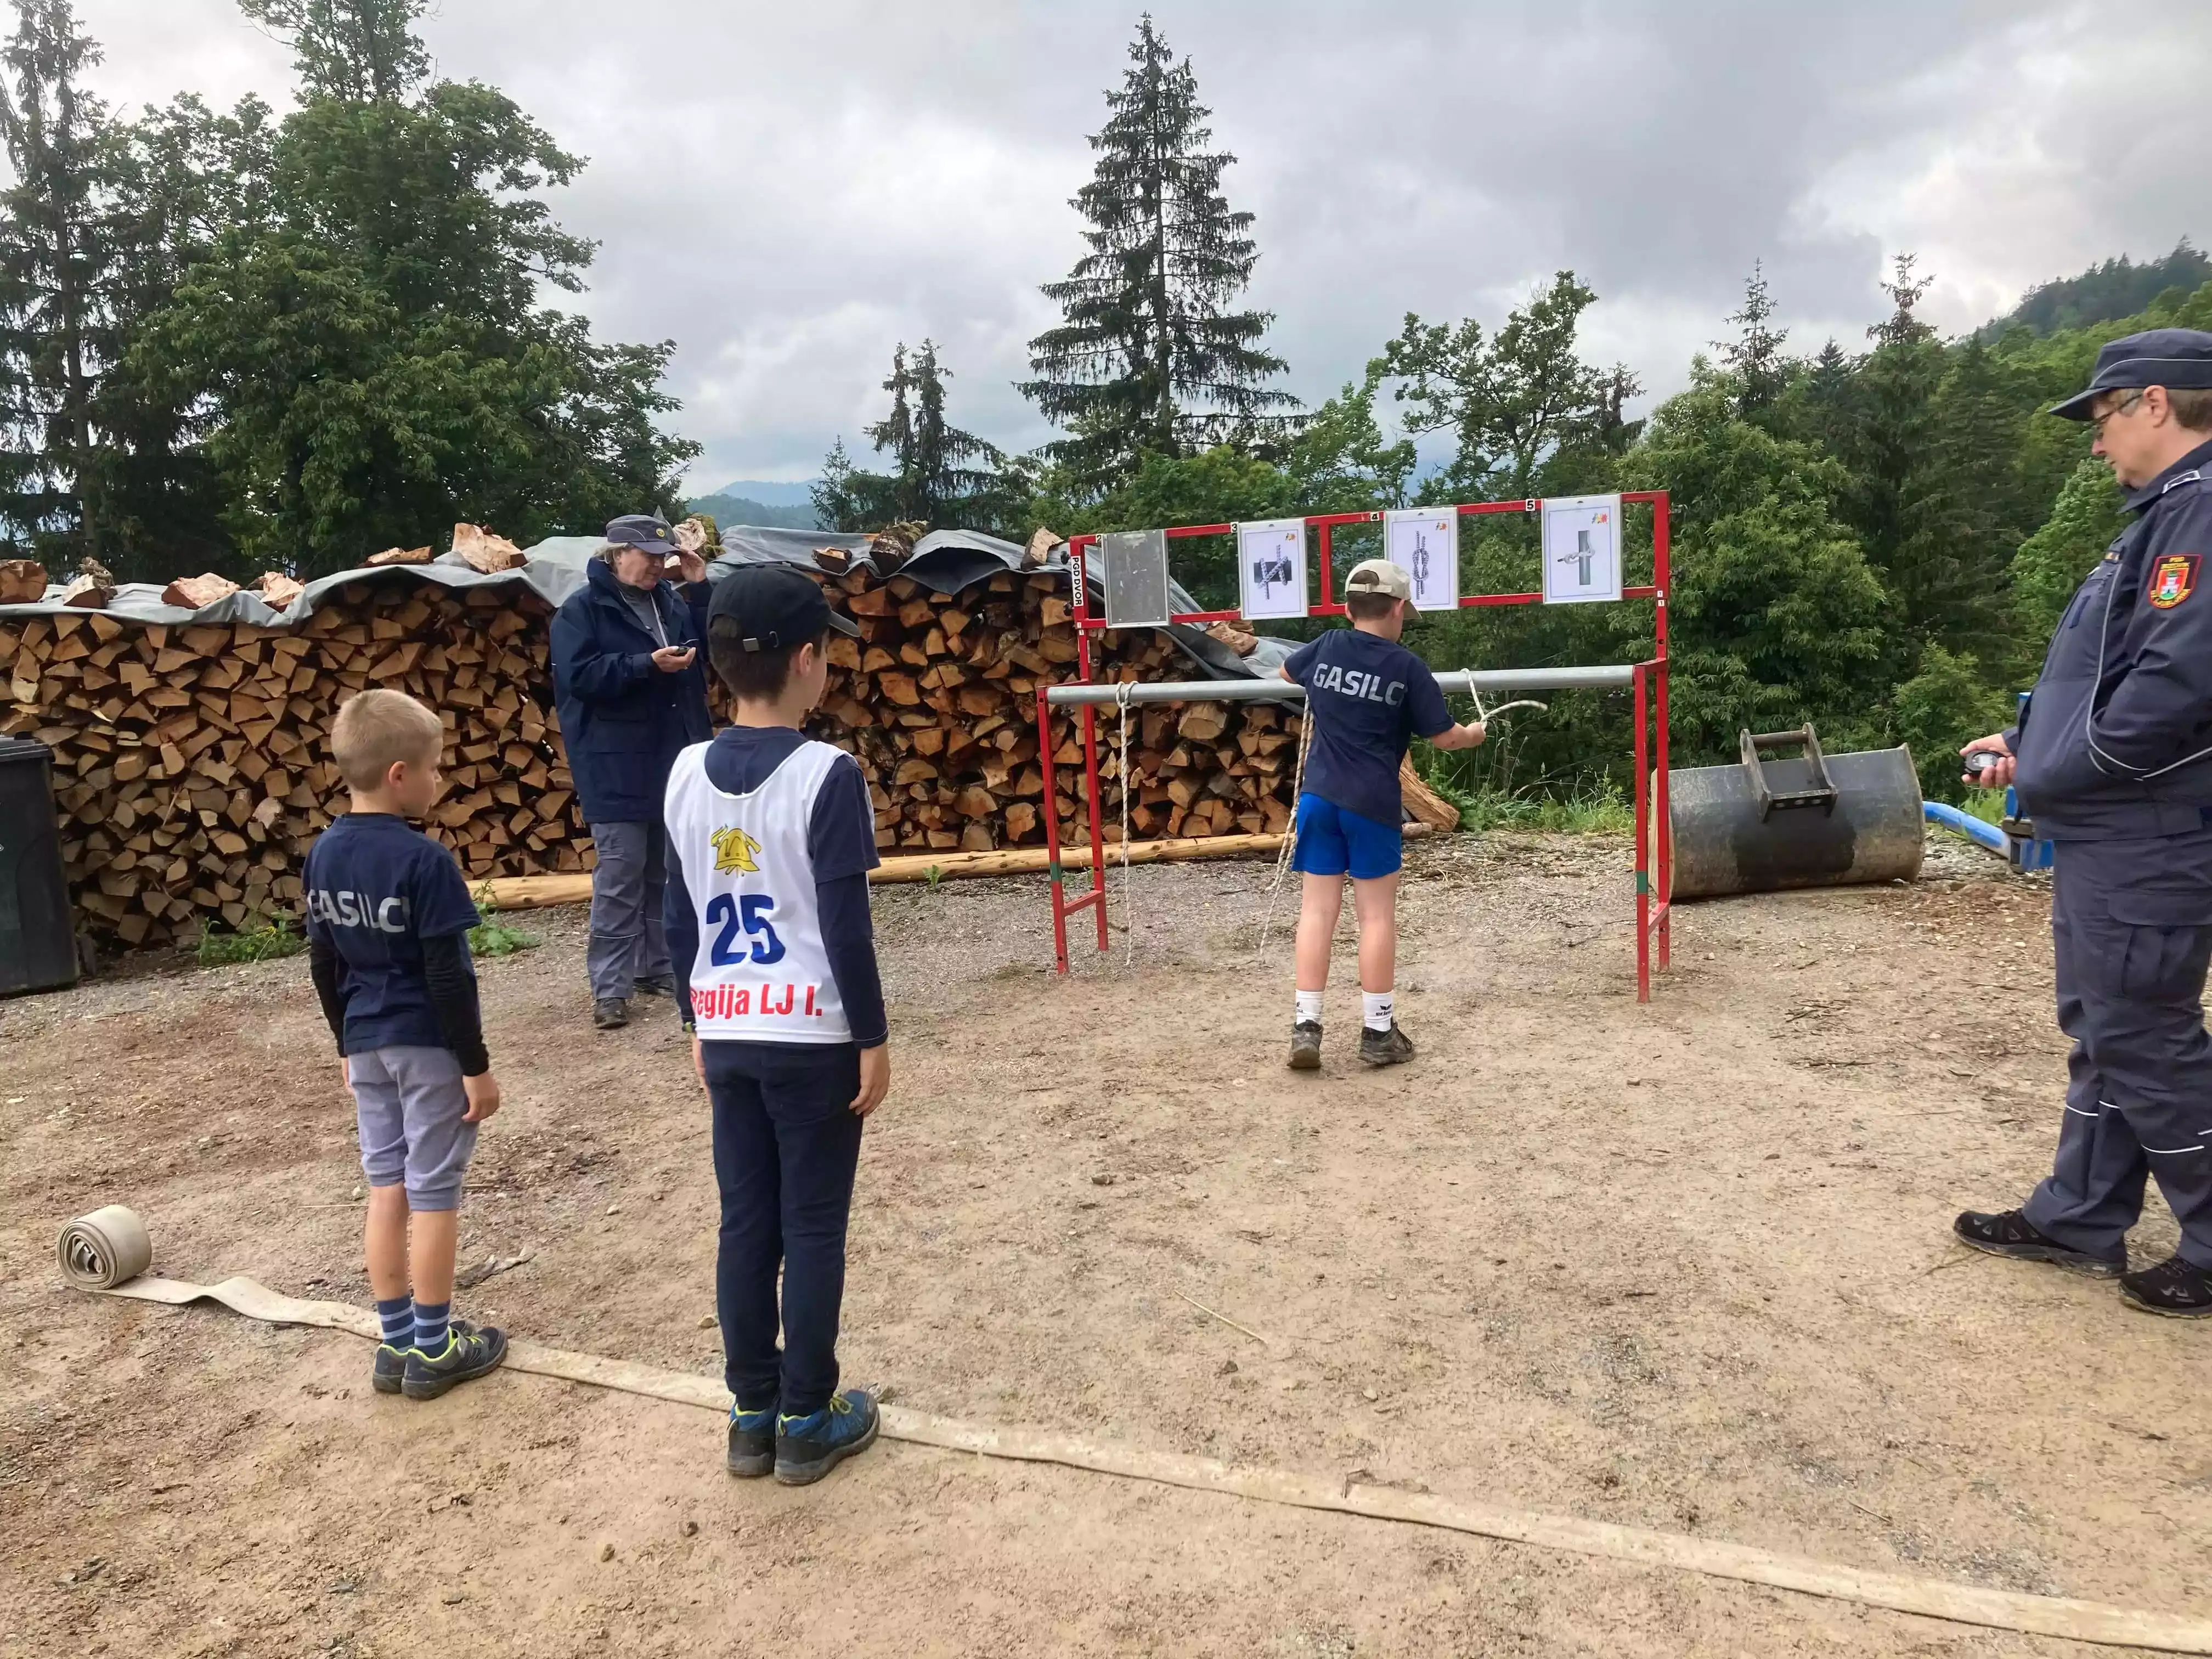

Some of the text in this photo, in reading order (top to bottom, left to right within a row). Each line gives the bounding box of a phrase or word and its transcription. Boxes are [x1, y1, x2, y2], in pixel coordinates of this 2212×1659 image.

[1527, 500, 1534, 510] 5
[1232, 523, 1238, 532] 3
[1097, 534, 1102, 543] 2
[1074, 579, 1082, 605] DVOR
[706, 893, 786, 967] 25
[760, 983, 795, 1015] LJ
[805, 985, 823, 1016] I.
